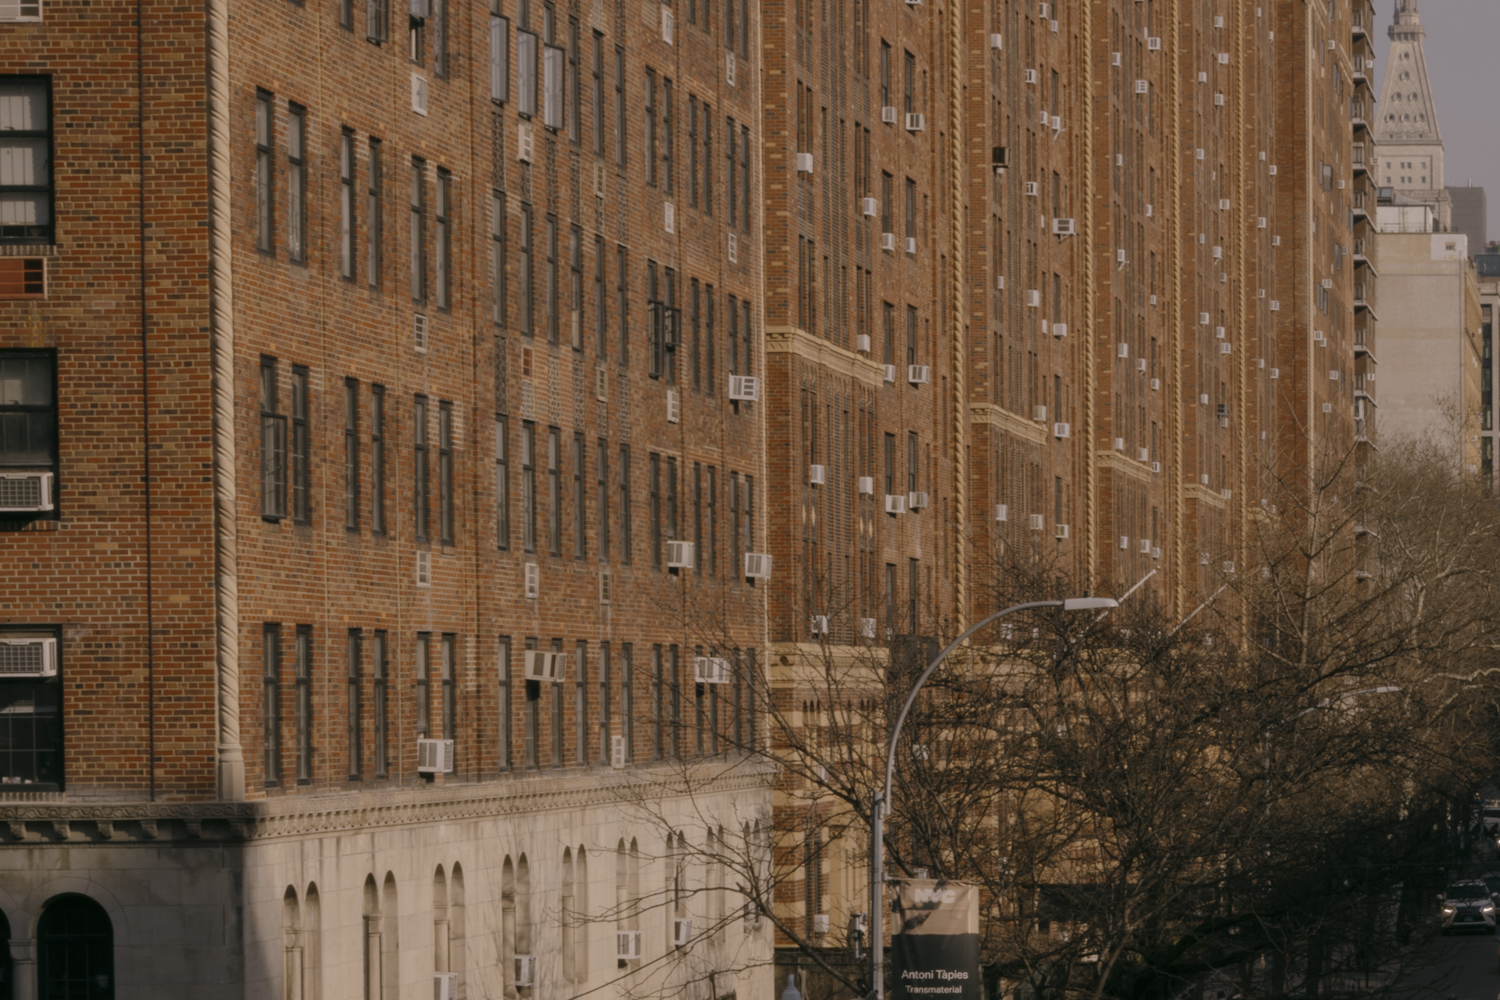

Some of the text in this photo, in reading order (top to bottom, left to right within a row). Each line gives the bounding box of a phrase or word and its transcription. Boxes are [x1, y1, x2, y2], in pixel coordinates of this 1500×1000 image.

[914, 888, 956, 903] NYC
[901, 969, 969, 981] Antoni Tàpies
[905, 985, 962, 994] Transmaterial
